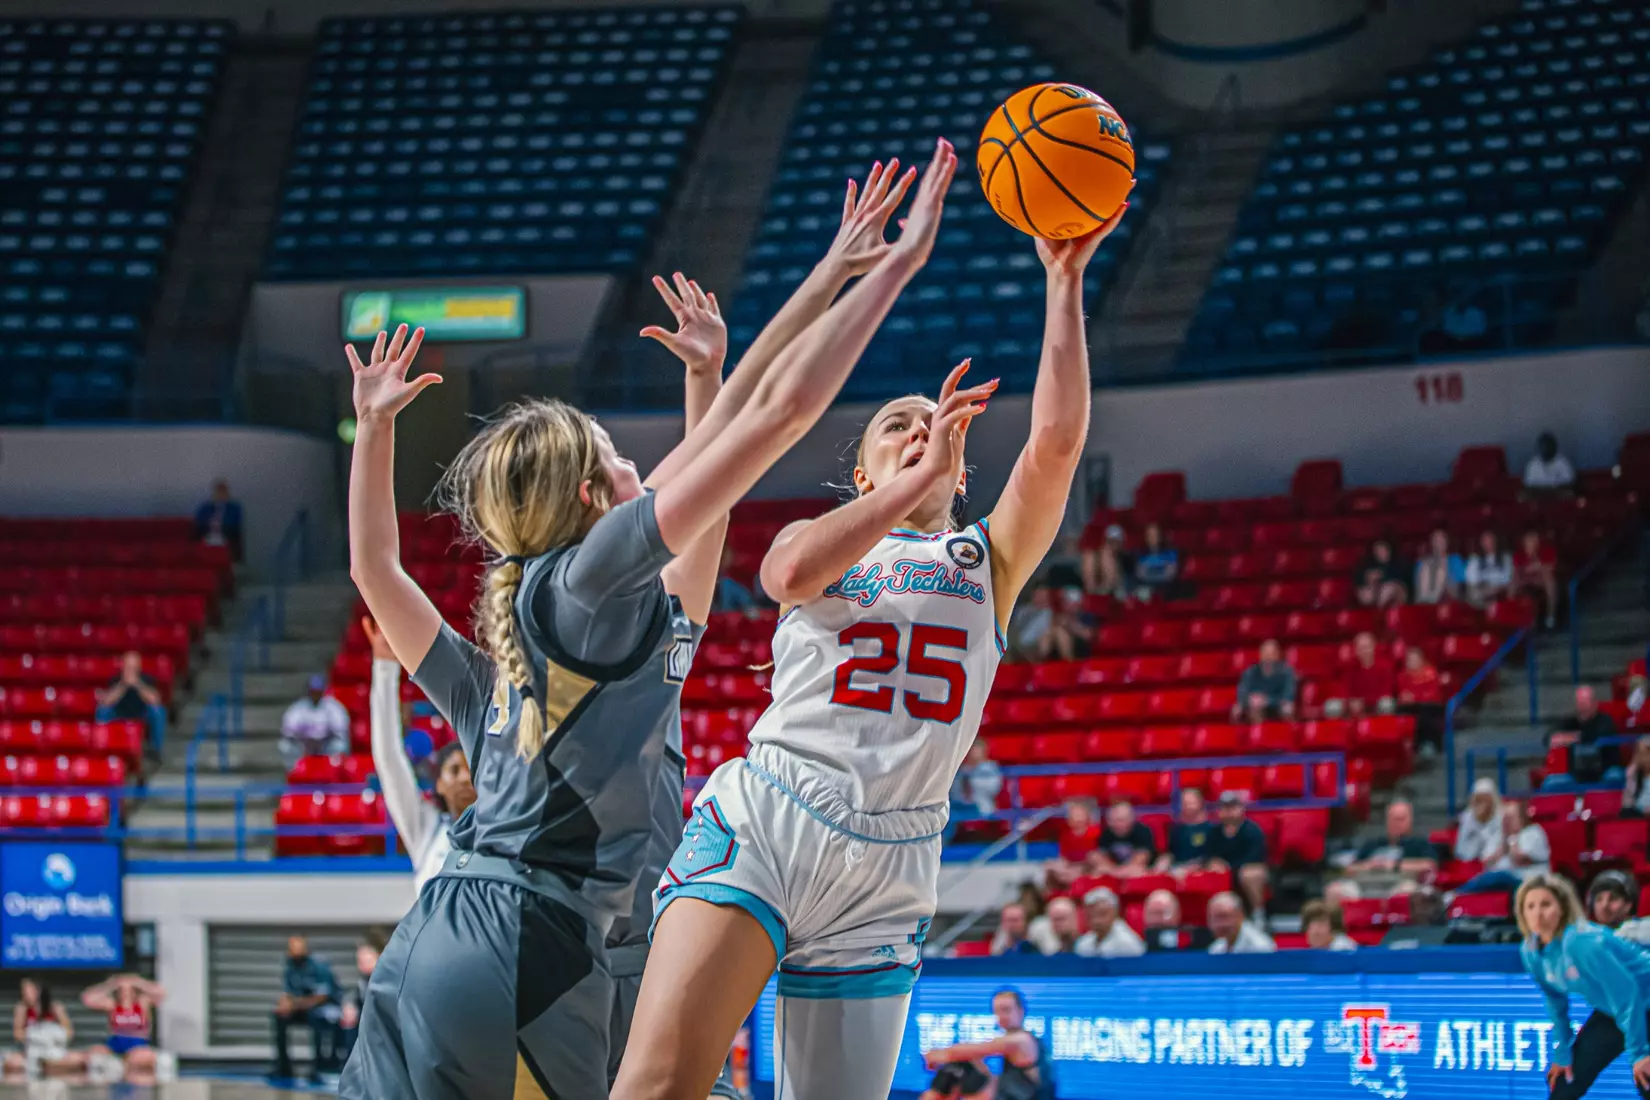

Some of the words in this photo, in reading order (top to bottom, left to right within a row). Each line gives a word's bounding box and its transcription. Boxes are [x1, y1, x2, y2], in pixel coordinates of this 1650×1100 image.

[823, 562, 886, 607] Lady
[884, 559, 985, 604] Techsters
[828, 620, 968, 726] 25
[1154, 1018, 1272, 1066] PARTNER
[1276, 1019, 1314, 1067] OF
[1433, 1020, 1560, 1071] ATHLET
